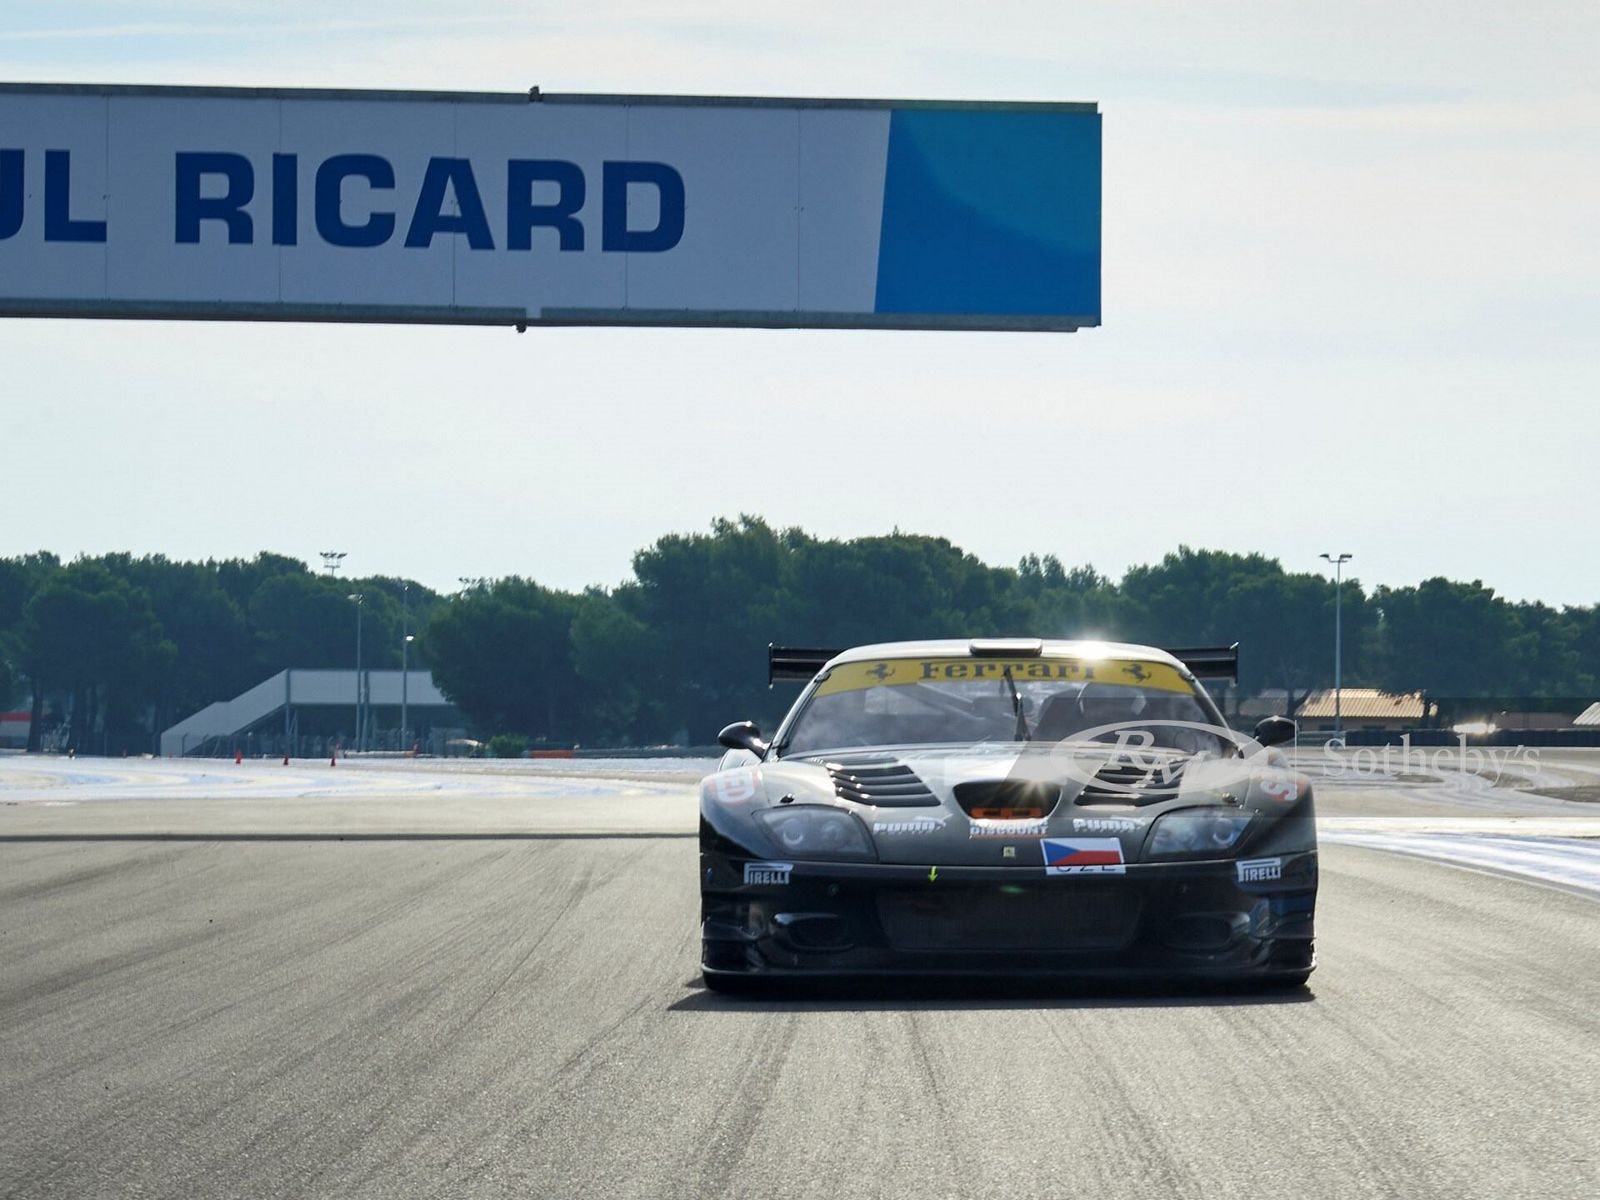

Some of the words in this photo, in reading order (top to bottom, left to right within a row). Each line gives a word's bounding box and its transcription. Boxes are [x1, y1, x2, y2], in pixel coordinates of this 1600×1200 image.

[174, 151, 686, 253] RICARD
[919, 661, 1096, 680] Ferrari
[744, 863, 793, 884] PIRELLI
[1236, 858, 1281, 882] PIRELLI
